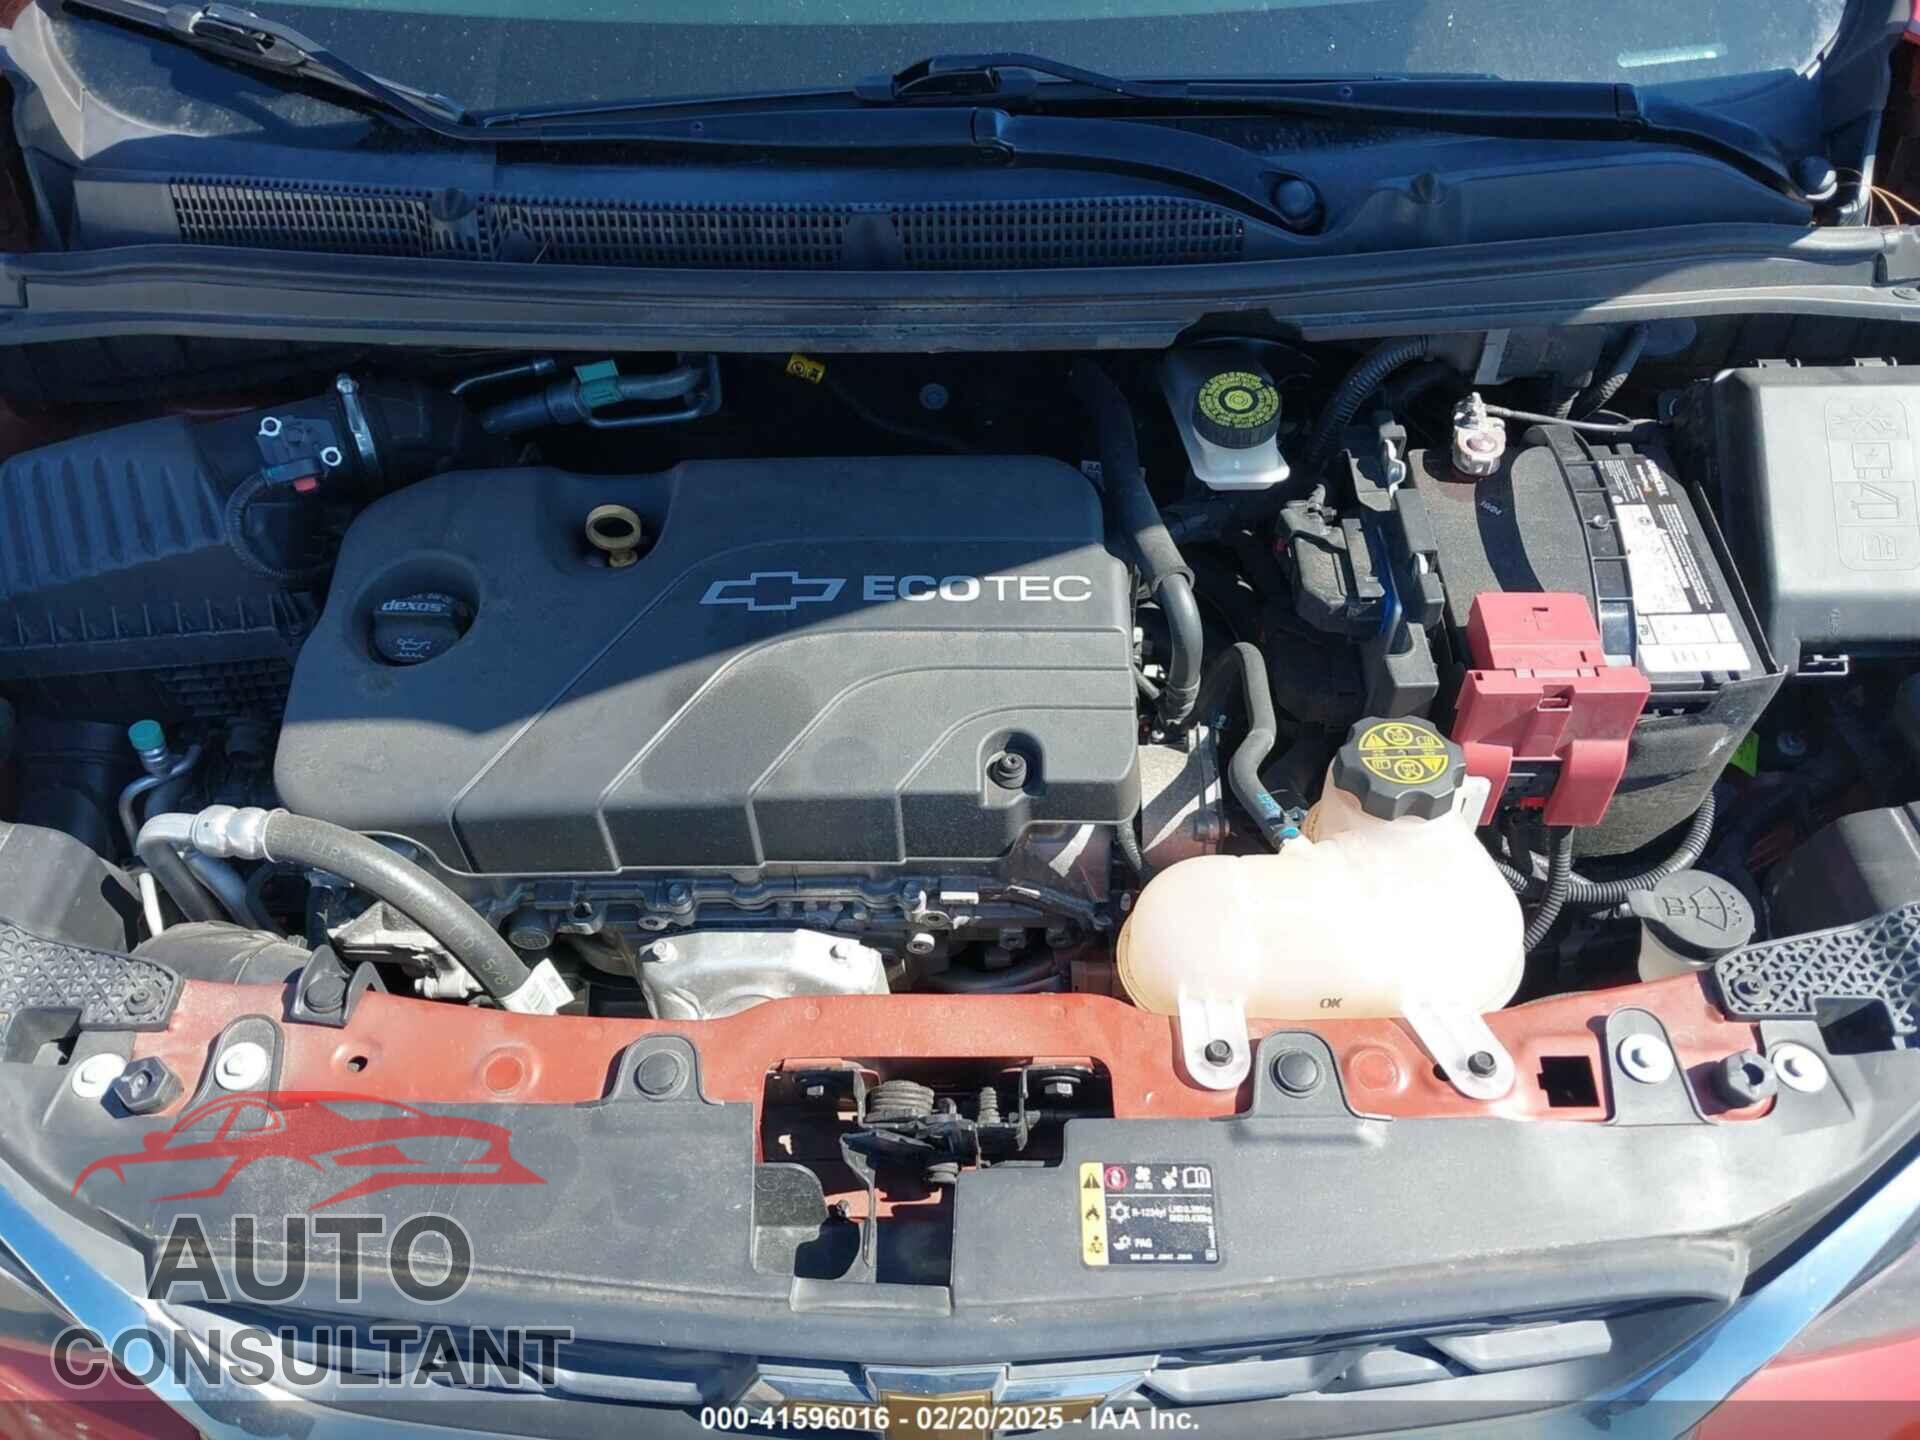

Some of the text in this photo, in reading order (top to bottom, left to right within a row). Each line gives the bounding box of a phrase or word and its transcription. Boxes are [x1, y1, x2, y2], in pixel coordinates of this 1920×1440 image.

[863, 575, 1092, 602] ECOTEC
[381, 600, 442, 612] dexos
[1319, 997, 1343, 1009] OK
